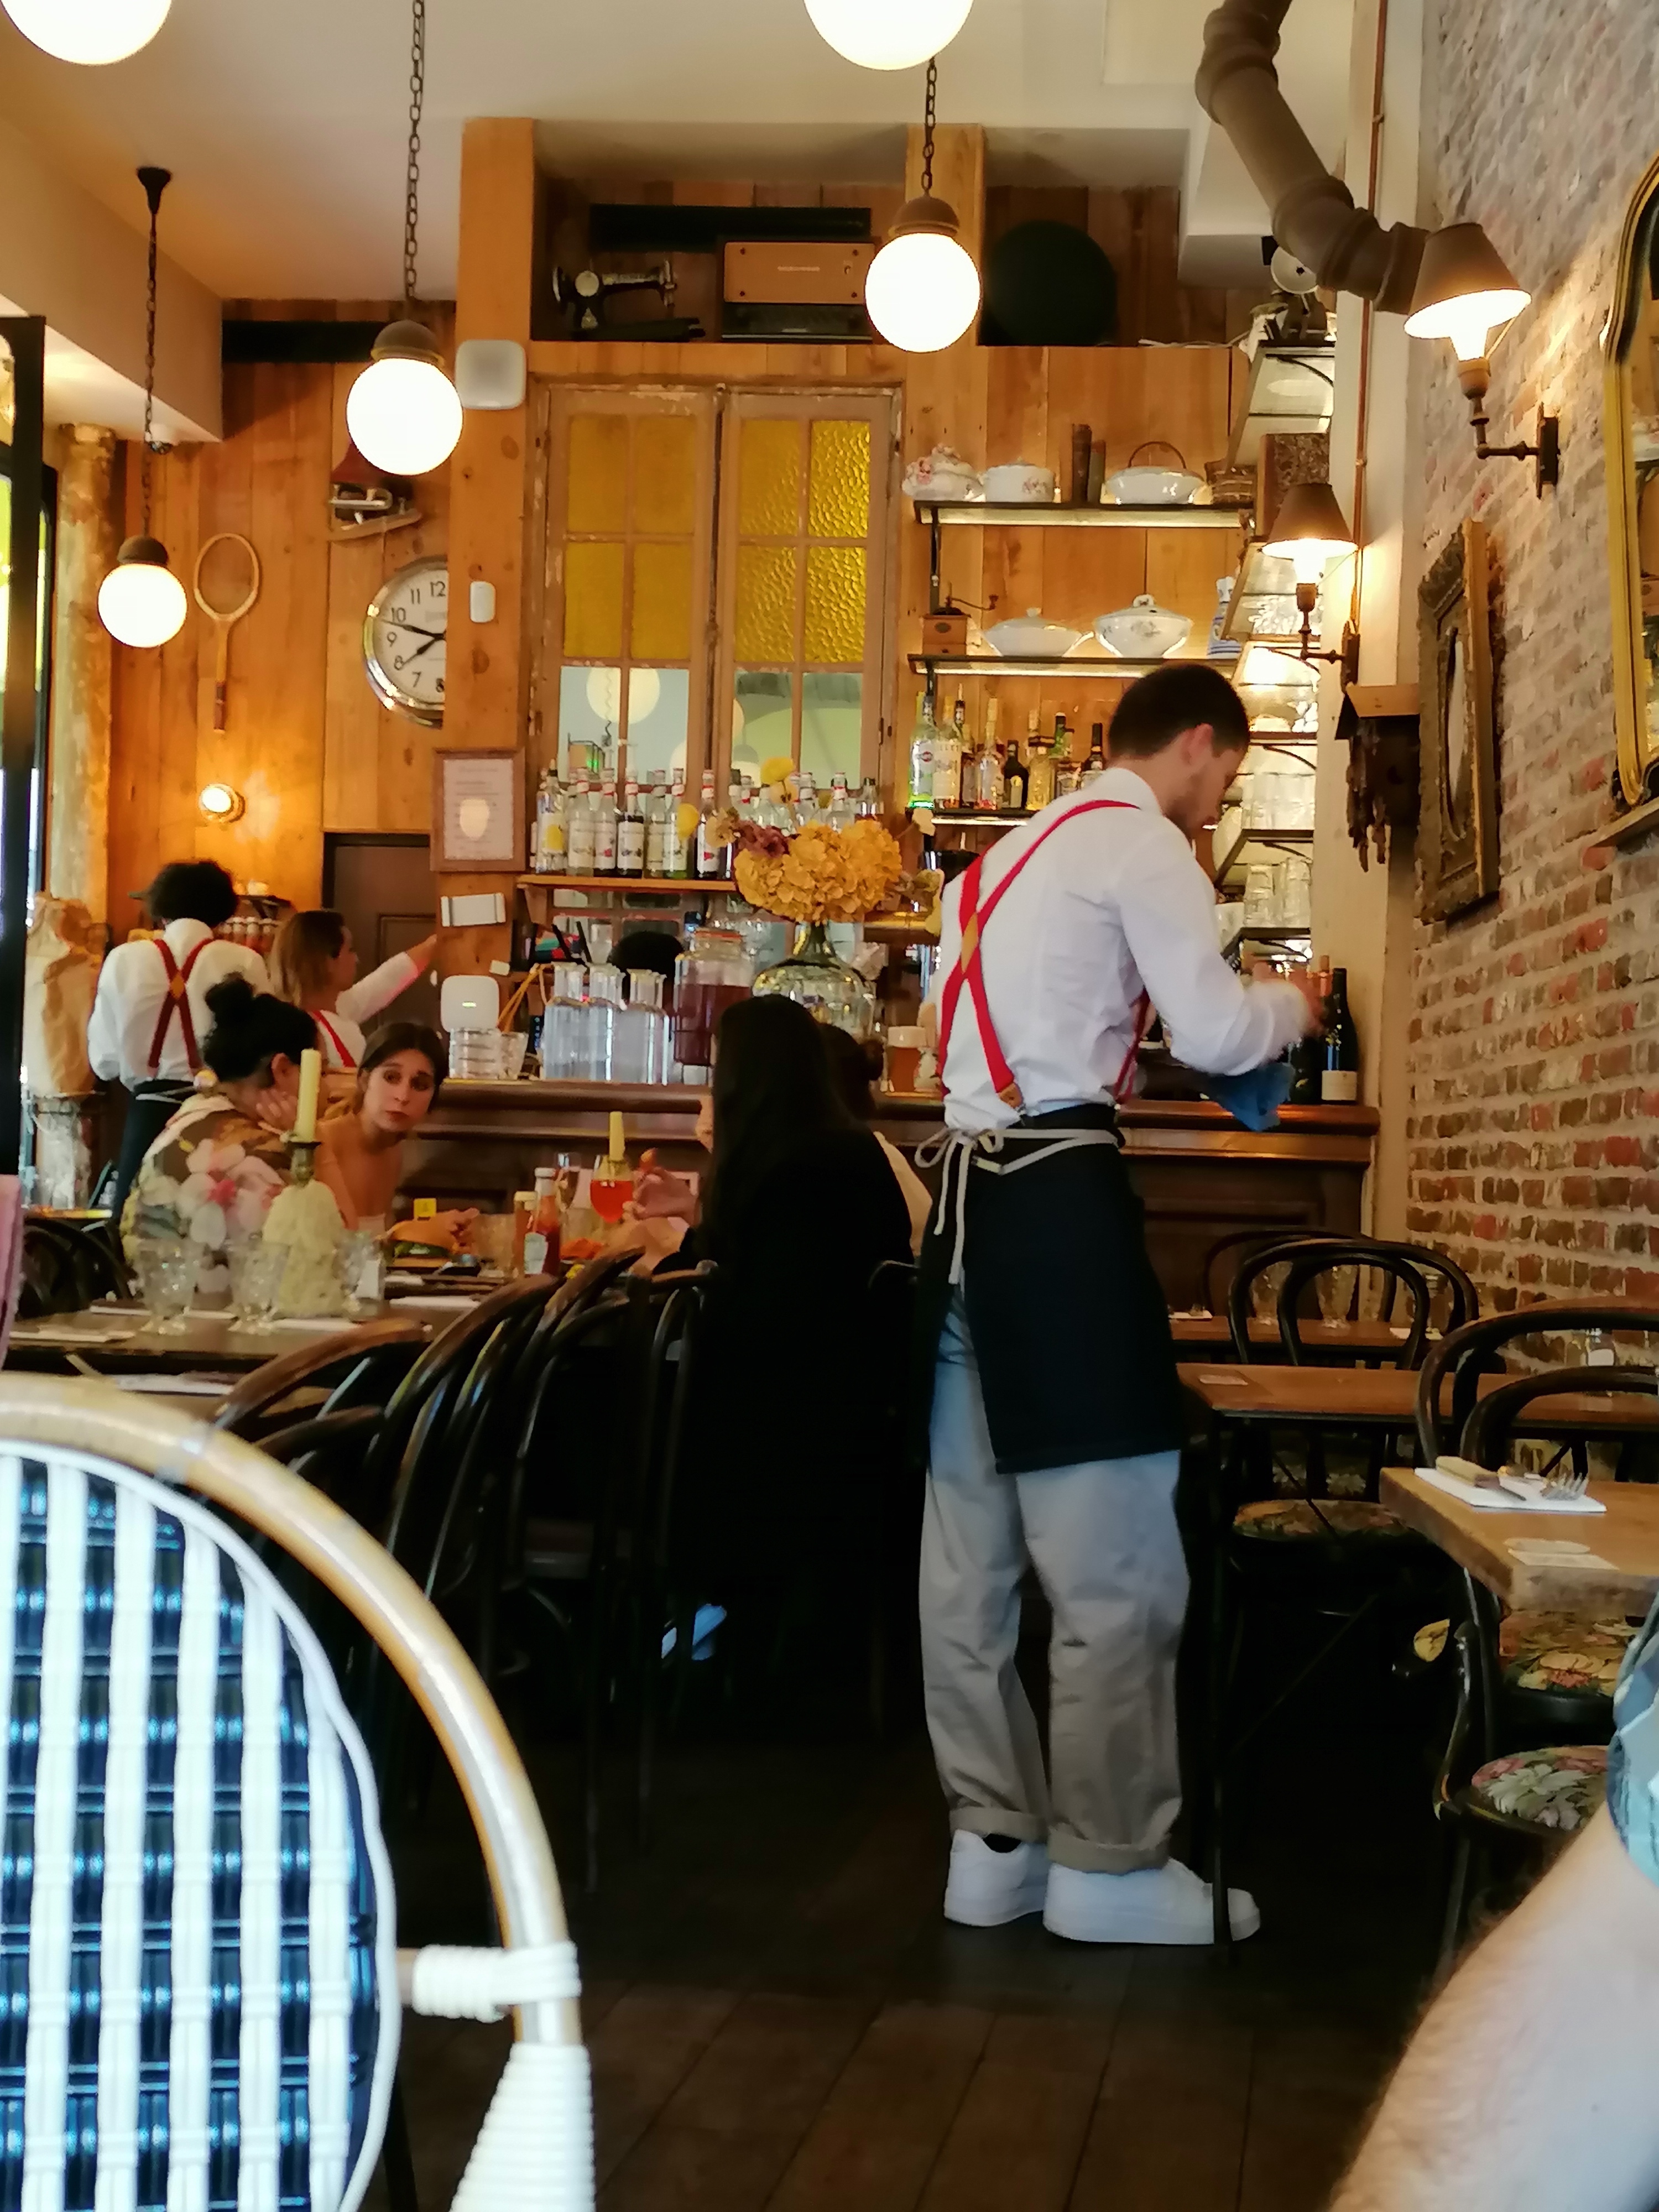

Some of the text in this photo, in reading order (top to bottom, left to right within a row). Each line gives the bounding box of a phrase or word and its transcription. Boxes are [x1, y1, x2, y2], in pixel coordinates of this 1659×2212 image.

[411, 588, 420, 604] 11
[430, 581, 446, 597] 12
[392, 608, 406, 622] 10
[387, 632, 397, 647] 9
[394, 655, 404, 670] 8
[412, 672, 421, 687] 7
